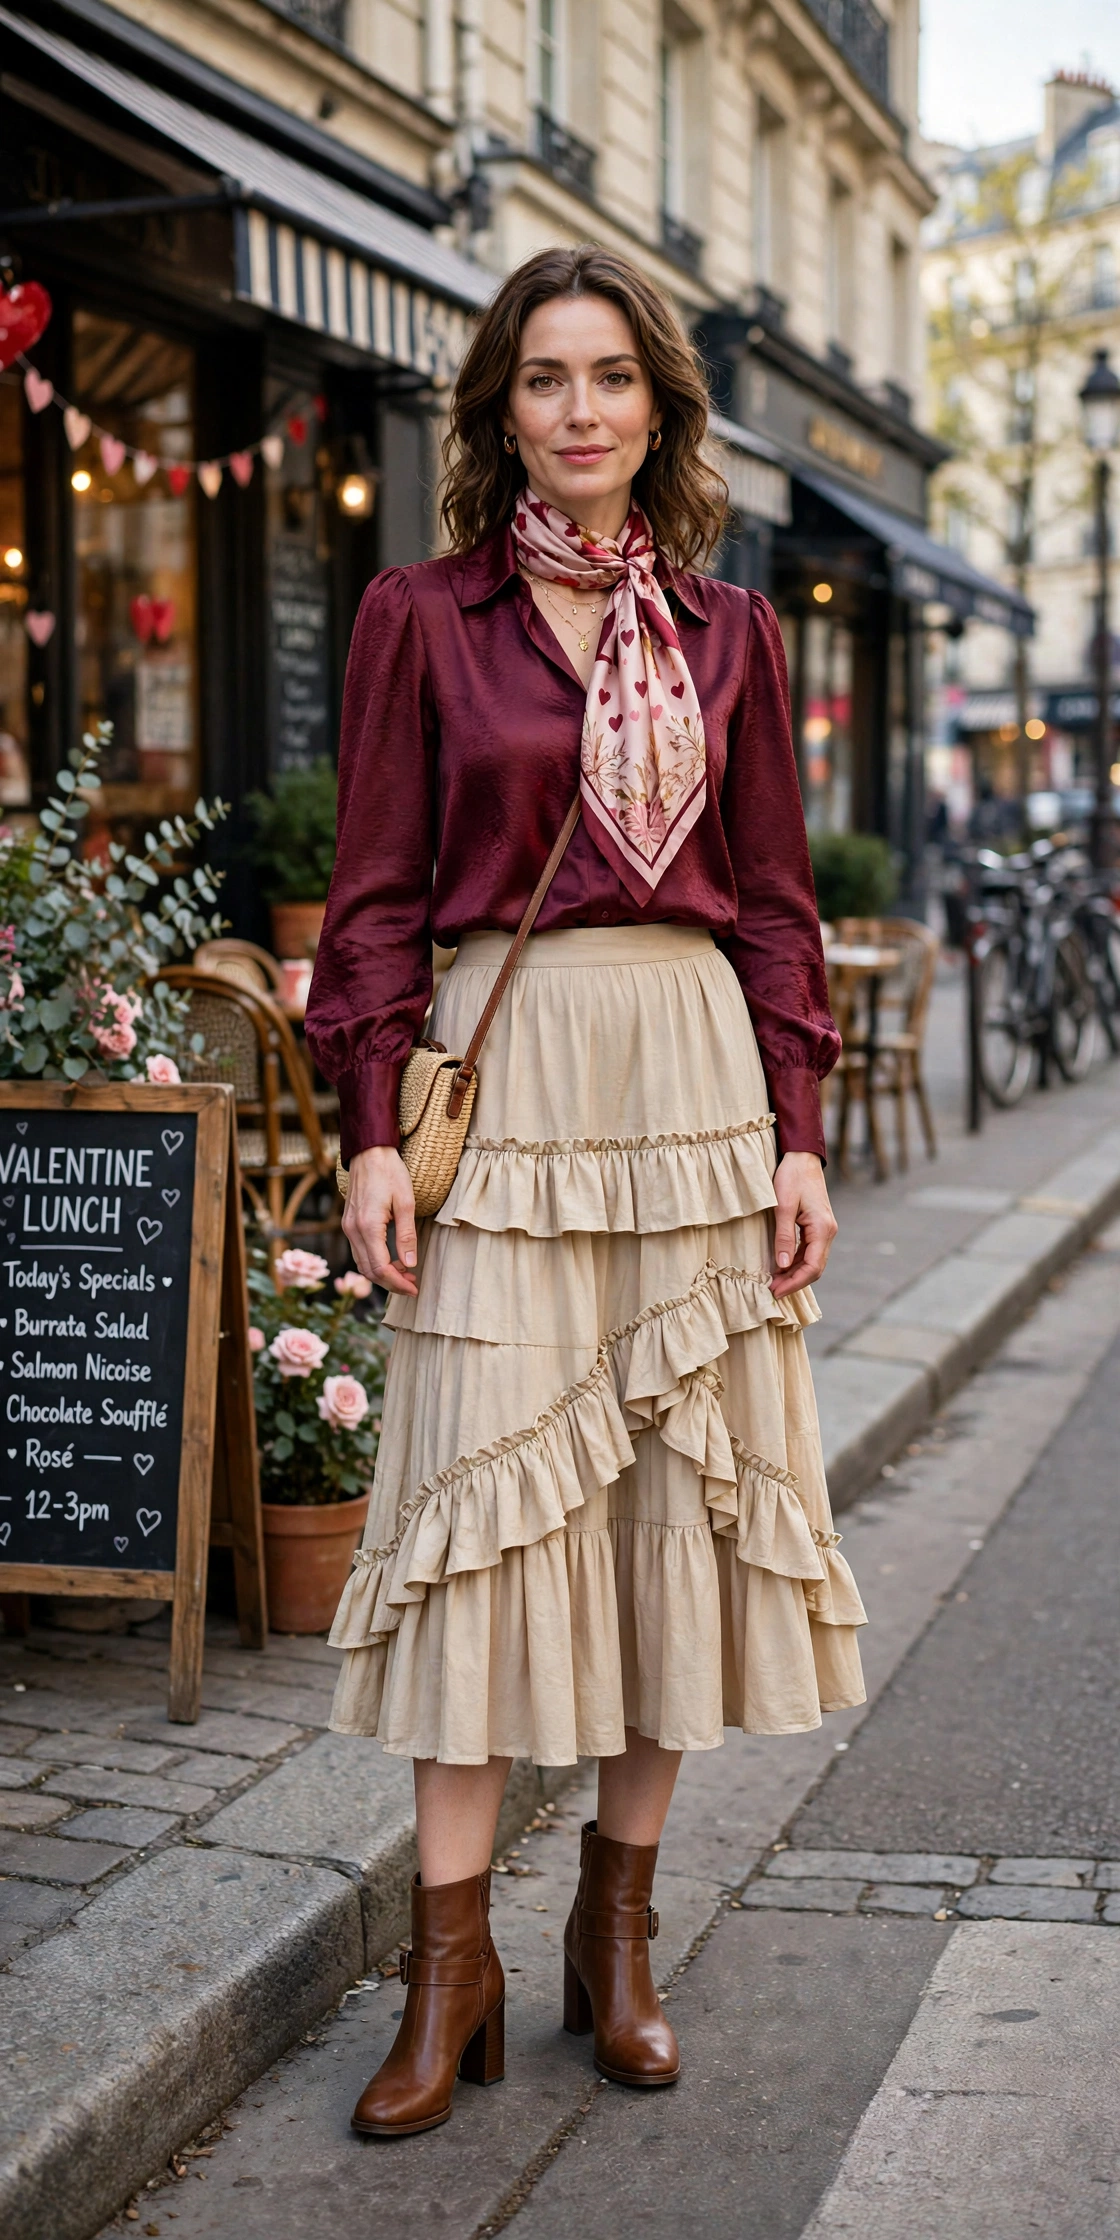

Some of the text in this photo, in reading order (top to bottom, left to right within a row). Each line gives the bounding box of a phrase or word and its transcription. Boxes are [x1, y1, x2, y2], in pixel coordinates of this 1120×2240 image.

[0, 1143, 154, 1188] VALENTINE
[23, 1194, 121, 1235] LUNCH
[2, 1260, 156, 1300] Today's Specials
[14, 1308, 150, 1341] Burrata Salad
[10, 1350, 152, 1383] Salmon Nicoise
[6, 1393, 169, 1432] Chocolate Soufflé
[25, 1438, 75, 1474] Rosé
[25, 1489, 110, 1532] 12-3pm
